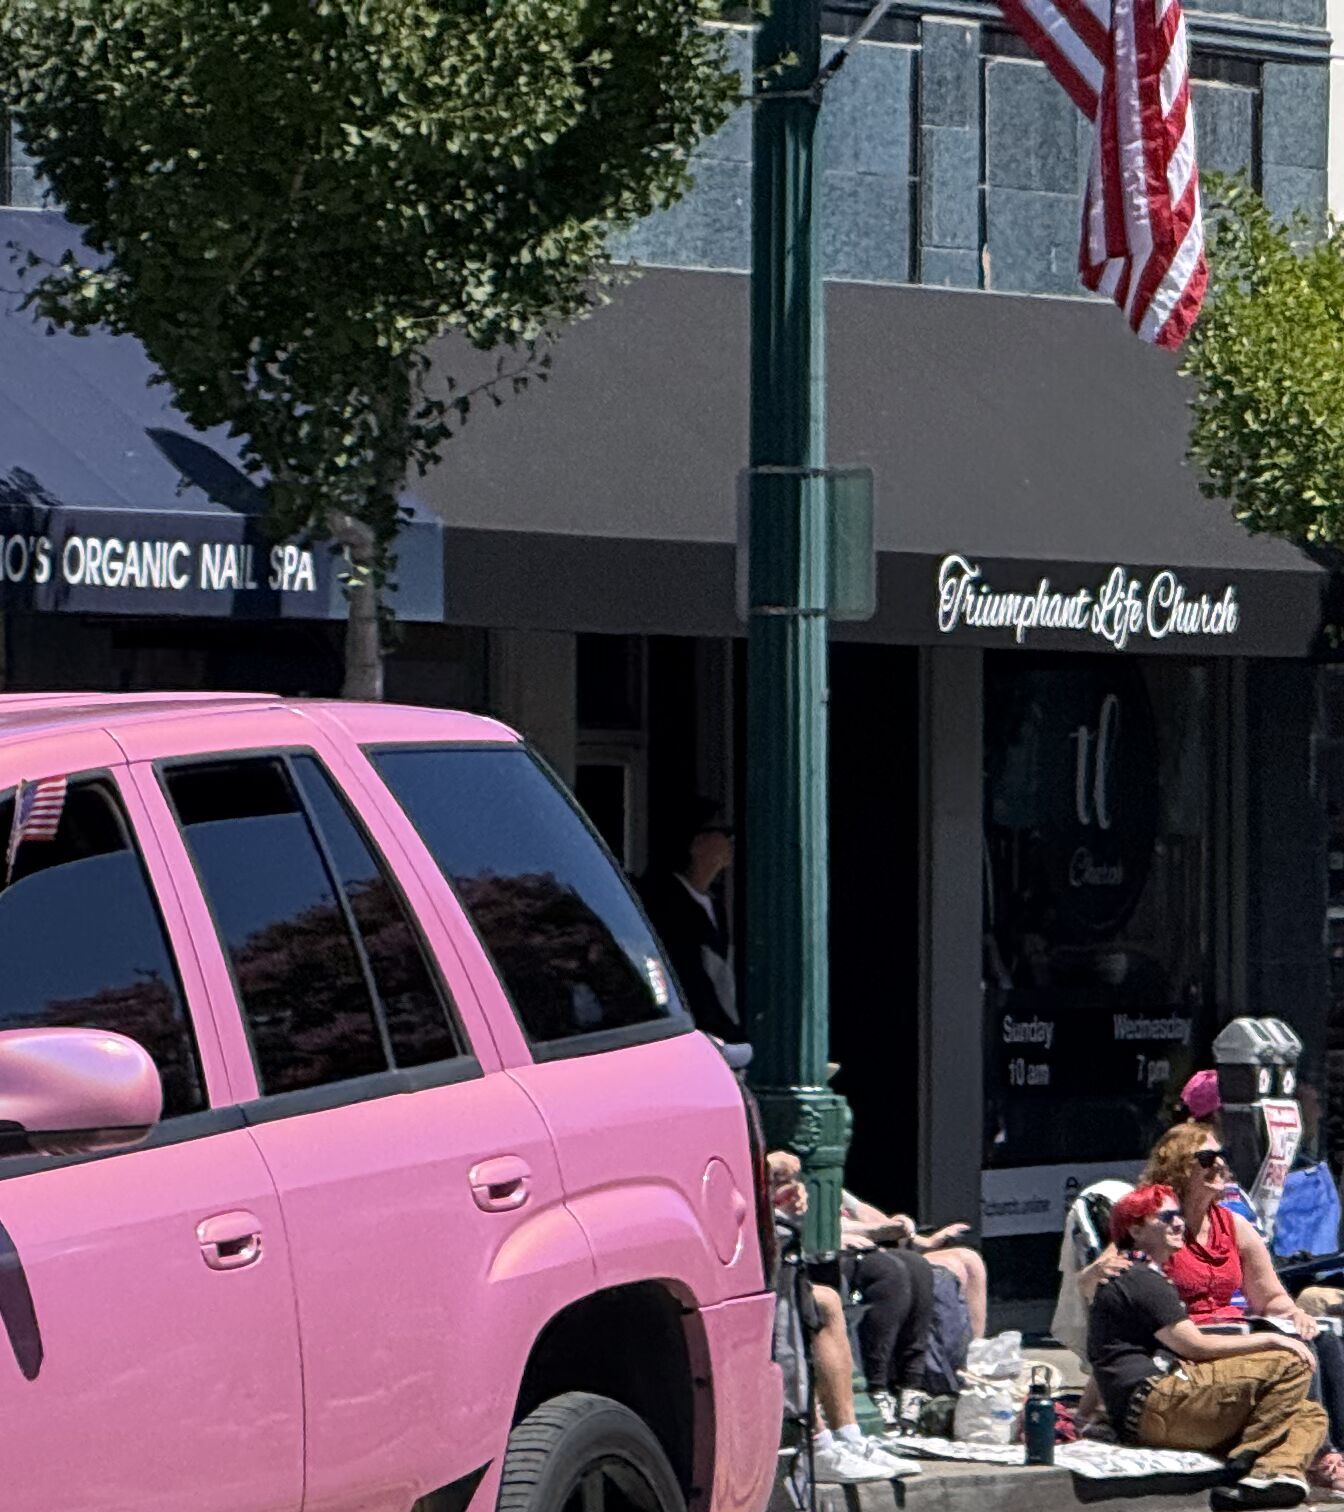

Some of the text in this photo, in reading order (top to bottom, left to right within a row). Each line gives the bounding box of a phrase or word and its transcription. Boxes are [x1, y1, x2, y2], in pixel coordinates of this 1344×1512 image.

[62, 536, 191, 590] ORGANIC
[200, 542, 258, 591] NAIL
[268, 544, 317, 592] SPA
[938, 554, 1241, 650] Triumphant Life Church
[1003, 1013, 1055, 1050] Sunday
[1113, 1012, 1193, 1047] Wednesday
